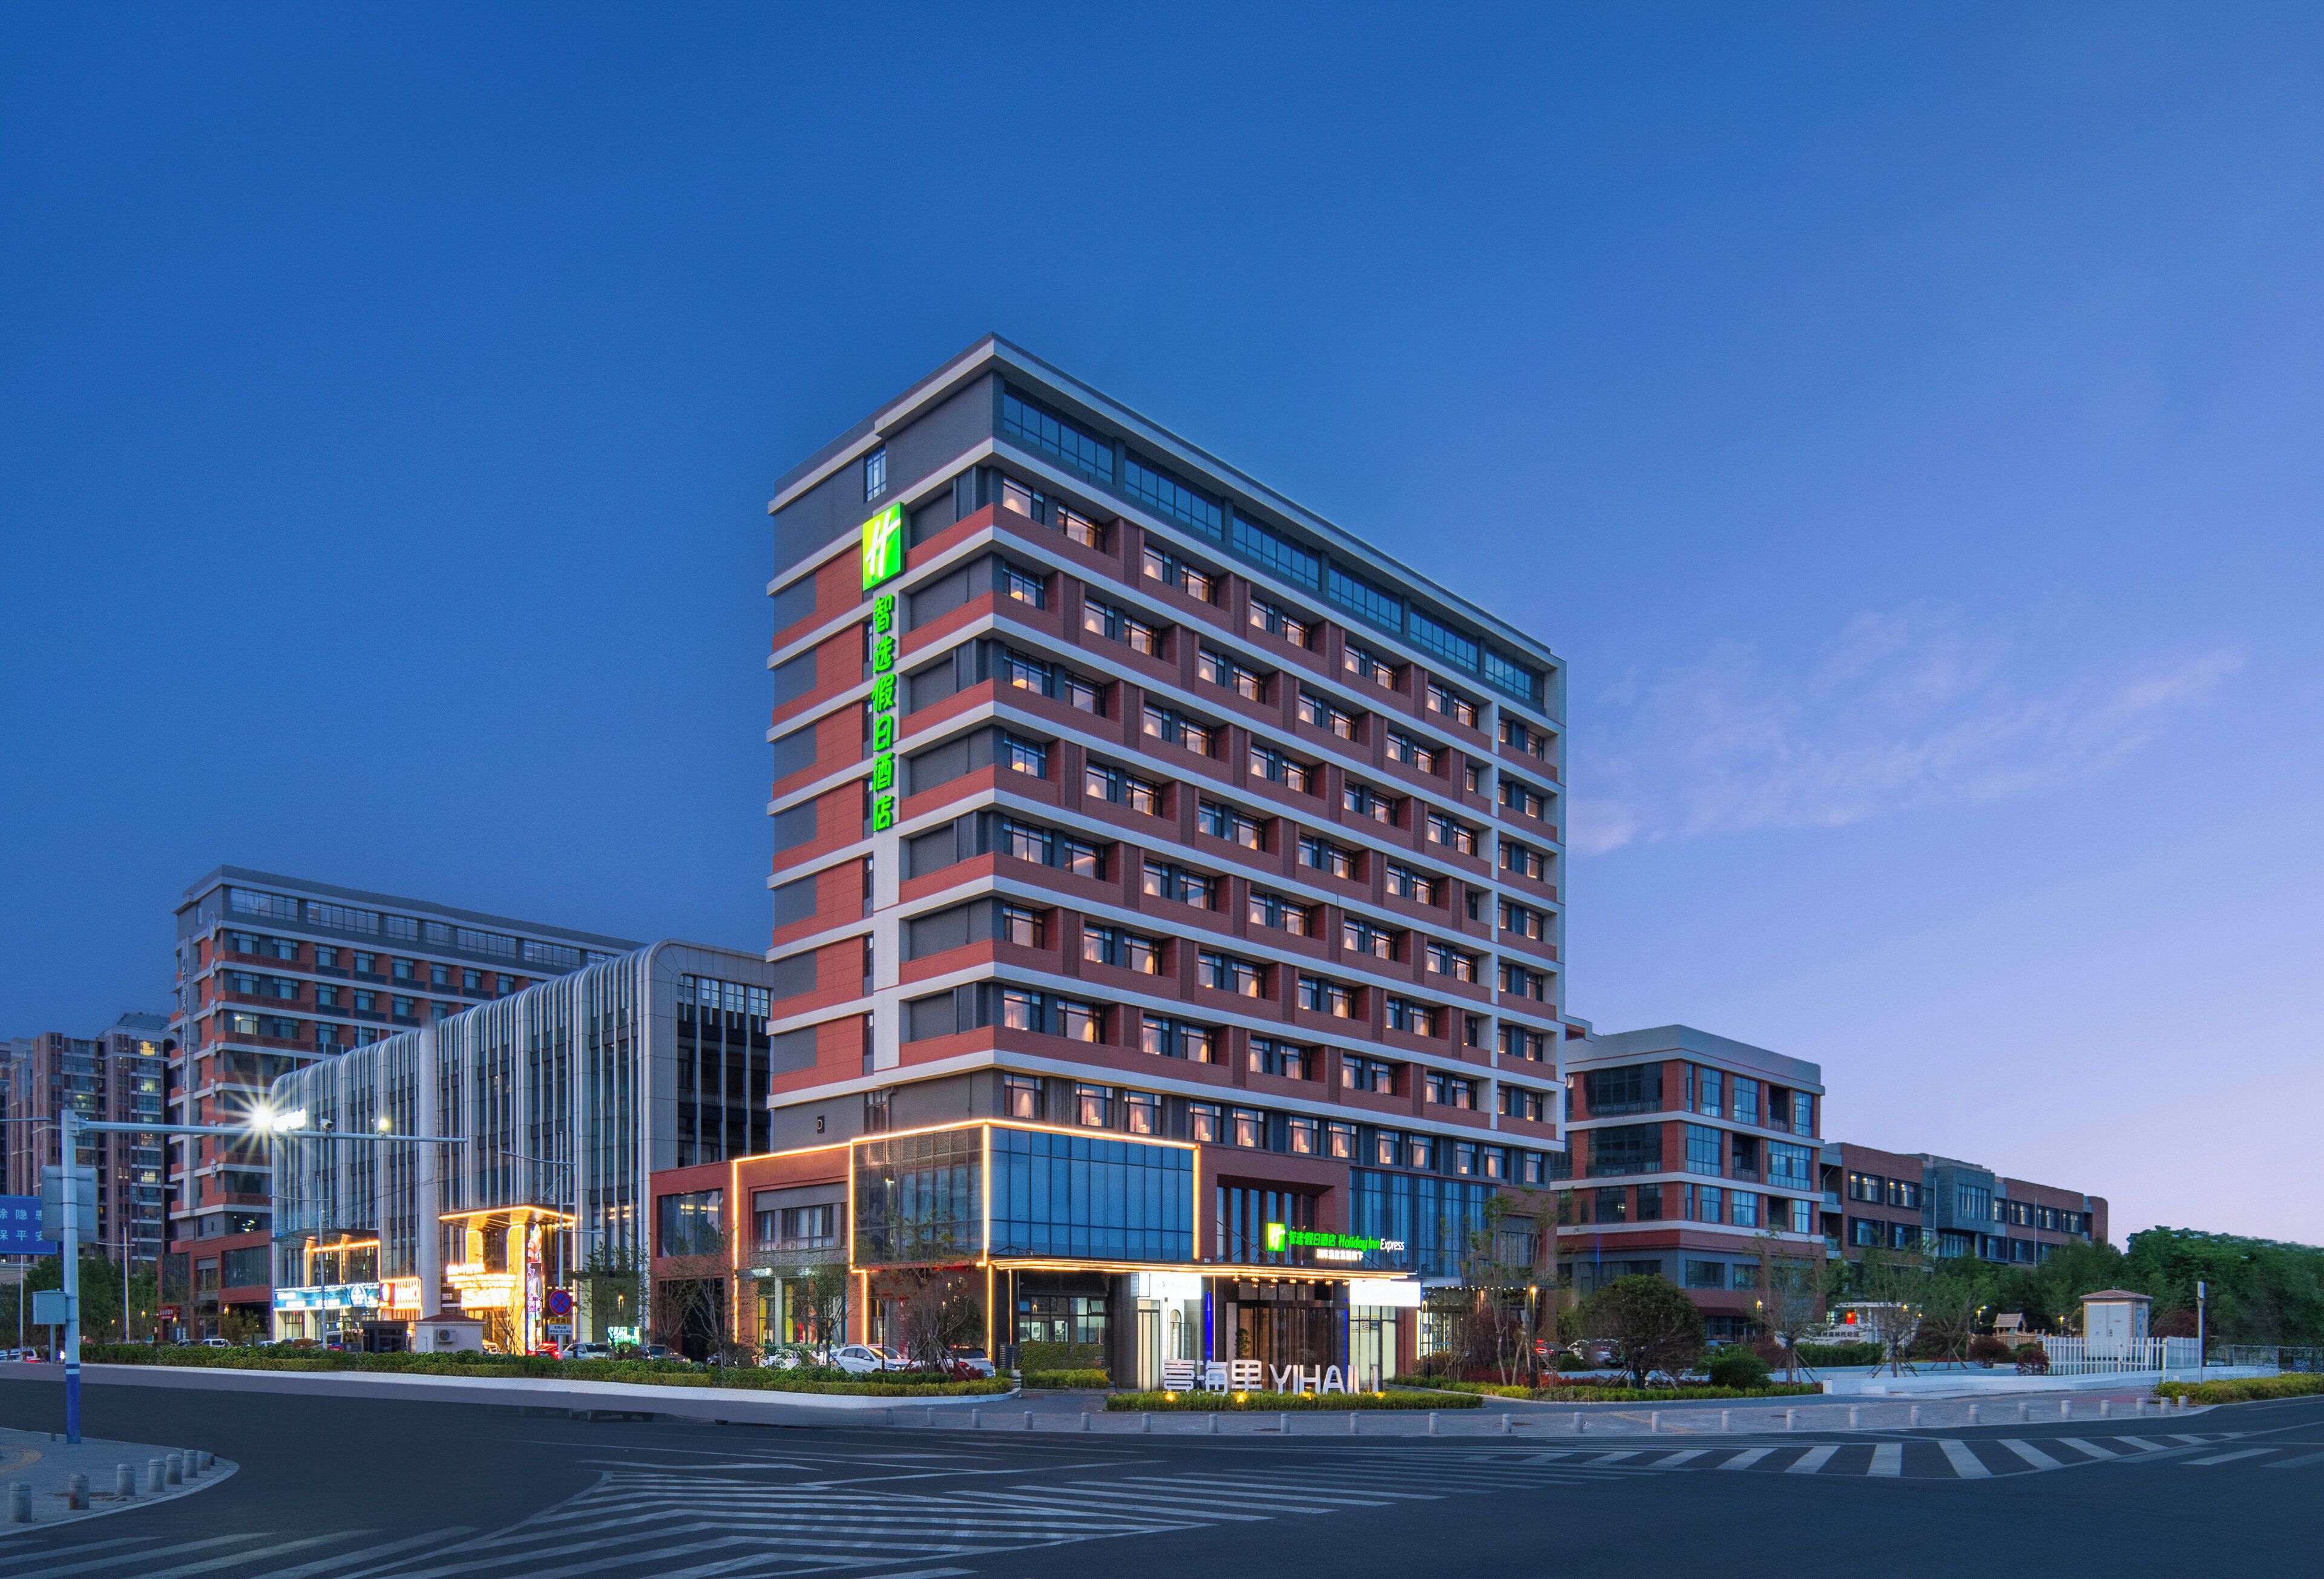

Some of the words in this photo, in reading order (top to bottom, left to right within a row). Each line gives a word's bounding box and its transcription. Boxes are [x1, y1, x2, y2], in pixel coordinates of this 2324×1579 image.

[871, 594, 896, 832] 智选假日酒店
[817, 1119, 823, 1130] D
[1288, 1230, 1337, 1247] 智选假日酒店
[1338, 1234, 1368, 1252] Holiday
[1368, 1236, 1380, 1249] Inn
[1380, 1238, 1405, 1252] Express
